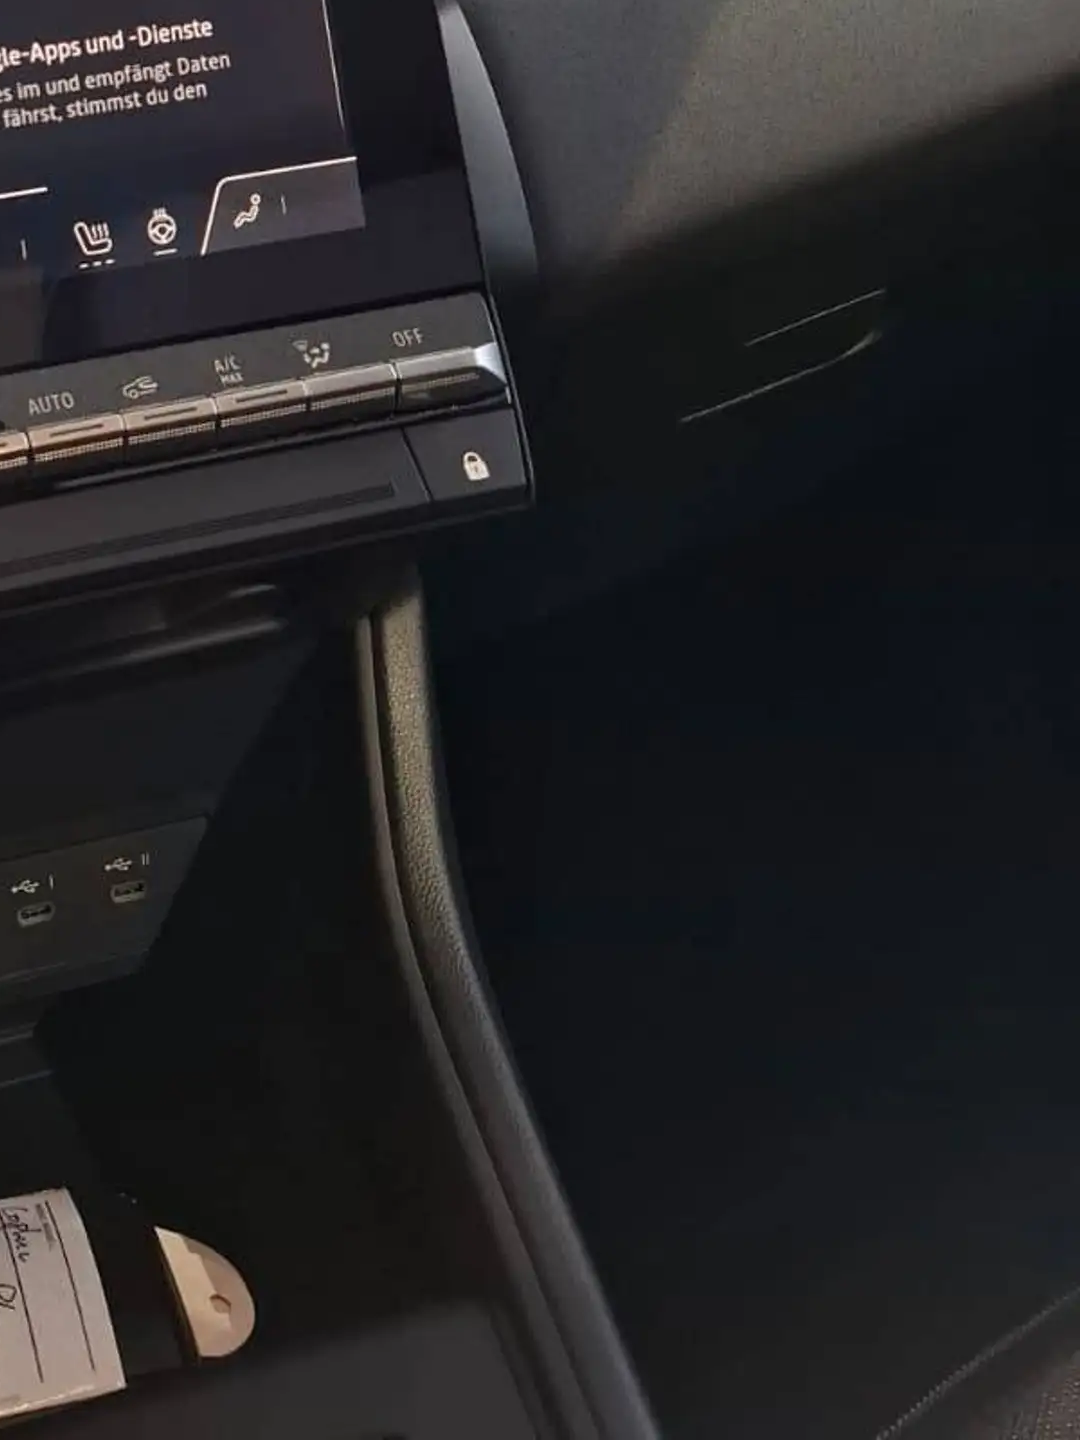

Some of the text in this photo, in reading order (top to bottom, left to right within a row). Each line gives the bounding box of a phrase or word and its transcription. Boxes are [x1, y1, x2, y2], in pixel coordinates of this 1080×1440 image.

[86, 29, 125, 54] und
[128, 19, 213, 47] -Dienste
[16, 82, 41, 100] im
[45, 74, 80, 96] und
[84, 61, 173, 90] empfängt
[176, 52, 231, 77] Daten
[3, 106, 63, 129] fährst,
[66, 92, 142, 118] stimmst
[146, 86, 170, 106] du
[173, 82, 208, 102] den
[391, 327, 424, 348] OFF
[213, 355, 242, 373] A/C
[220, 372, 244, 385] MAX
[28, 392, 74, 415] AUTO
